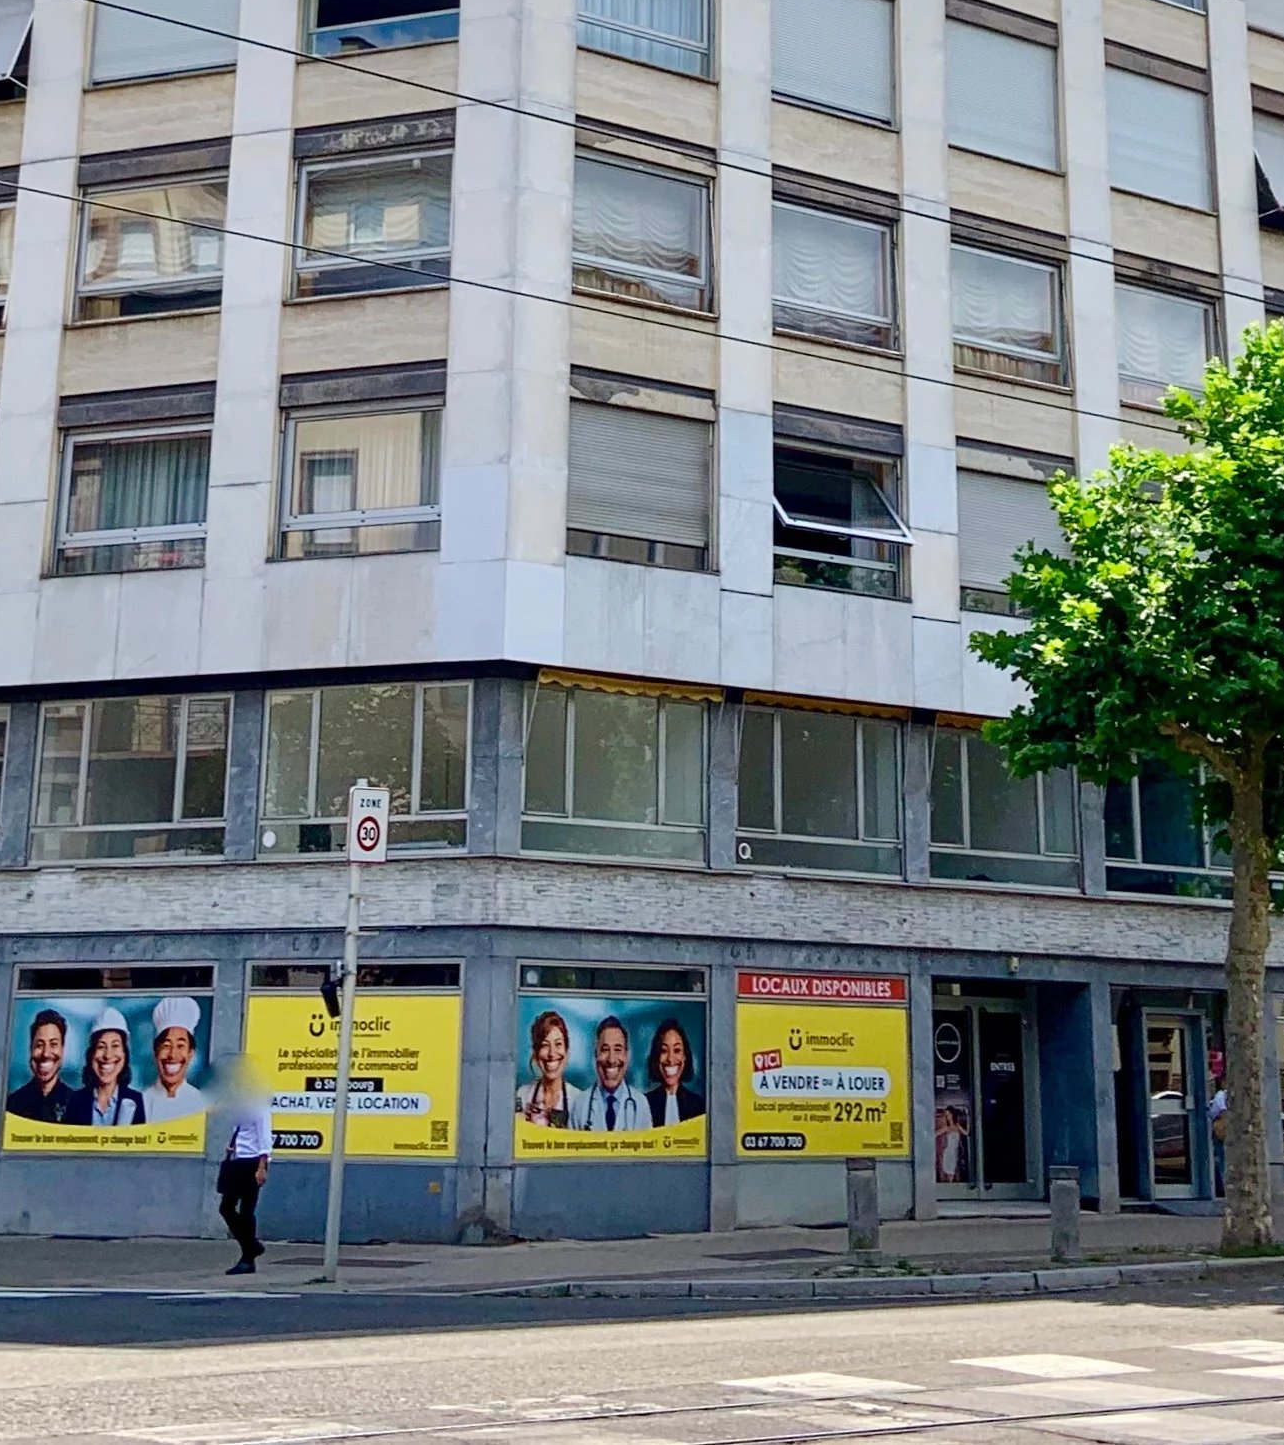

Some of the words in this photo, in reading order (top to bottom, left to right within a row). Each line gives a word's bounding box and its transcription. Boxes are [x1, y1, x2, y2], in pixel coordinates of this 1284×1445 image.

[360, 798, 382, 809] ZONE
[361, 826, 376, 841] 30
[752, 976, 809, 995] LOCAUX
[812, 979, 892, 997] DISPONIBLES
[805, 1030, 855, 1047] immoclic
[278, 1047, 290, 1058] Le
[291, 1046, 339, 1060] spécialist
[764, 1052, 781, 1068] ICI
[278, 1059, 339, 1072] professionne
[357, 1060, 418, 1071] commercial
[324, 1078, 375, 1092] Strbourg
[772, 1075, 819, 1090] VENDRE
[836, 1072, 846, 1091] À
[848, 1076, 885, 1091] LOUER
[271, 1096, 314, 1110] ACHAT,
[316, 1096, 355, 1110] VEE,
[358, 1096, 419, 1110] LOCATION
[833, 1102, 863, 1123] 292
[279, 1134, 299, 1147] 700
[300, 1134, 320, 1147] 700
